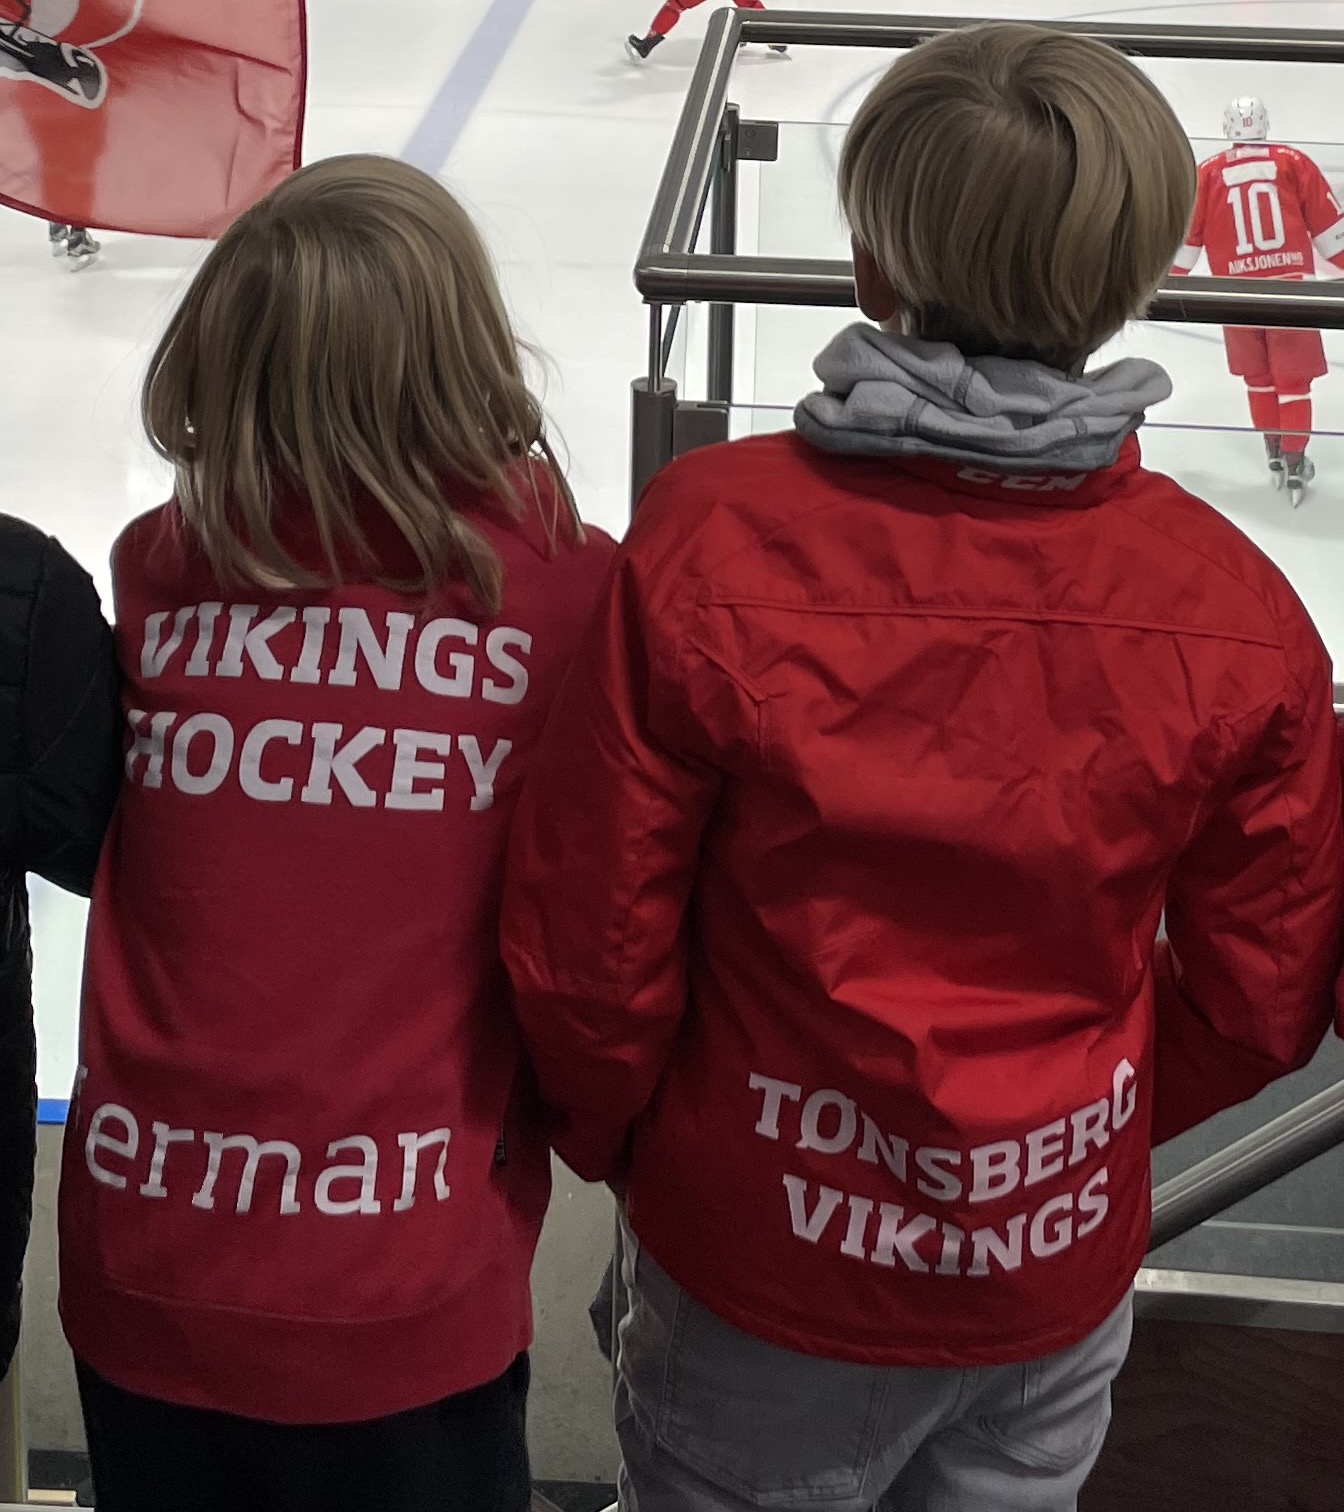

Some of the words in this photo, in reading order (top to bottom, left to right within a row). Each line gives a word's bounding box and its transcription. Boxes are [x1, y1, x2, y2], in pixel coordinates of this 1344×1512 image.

[1227, 182, 1286, 256] 10
[140, 600, 533, 705] VIKINGS
[123, 708, 513, 812] HOCKEY
[84, 1100, 452, 1216] erman
[748, 1057, 1138, 1203] TØNSBERG
[782, 1166, 1109, 1277] VIKINGS
